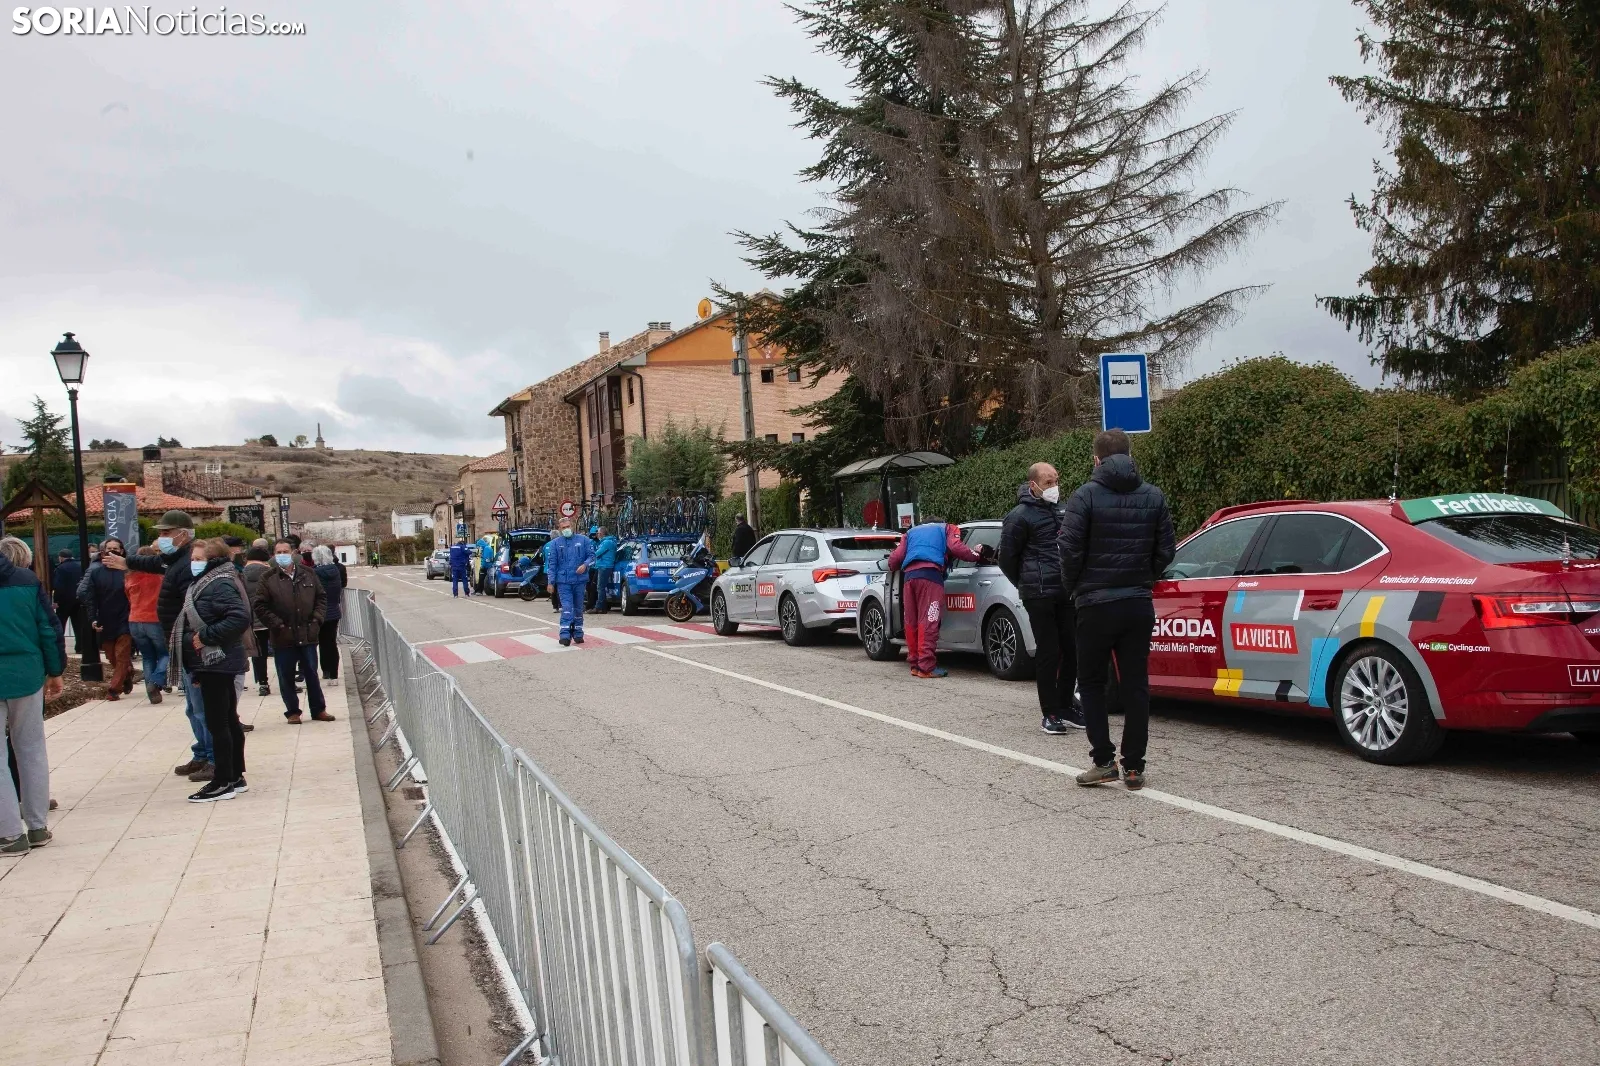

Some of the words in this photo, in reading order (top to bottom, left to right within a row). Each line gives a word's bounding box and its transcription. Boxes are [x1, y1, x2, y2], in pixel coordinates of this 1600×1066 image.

[1431, 493, 1542, 515] Fertiberia
[1380, 575, 1419, 584] Comisario
[1419, 576, 1477, 585] Internacional
[1236, 627, 1249, 646] LA
[1250, 628, 1292, 649] VUELTA
[1149, 641, 1171, 652] Official
[1171, 642, 1189, 652] Main
[1189, 643, 1217, 654] Partner
[1418, 642, 1430, 650] We
[1448, 643, 1490, 653] Cycling.com
[1576, 668, 1591, 683] LA
